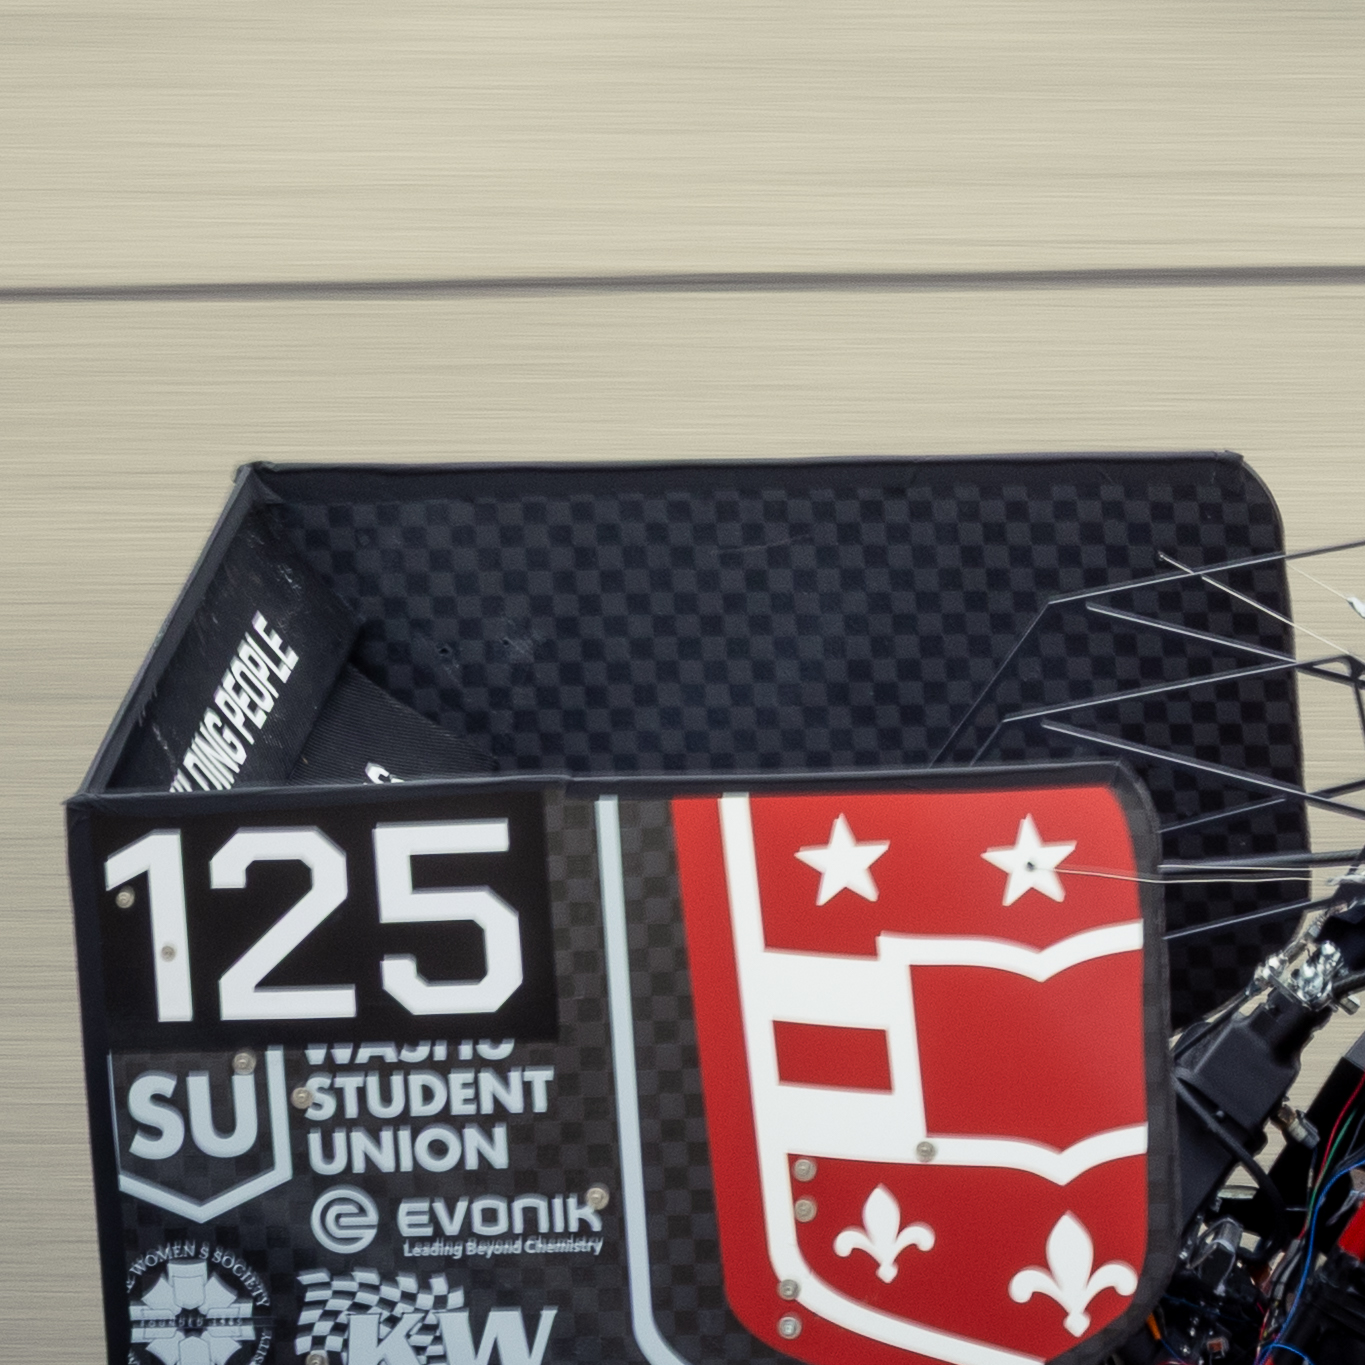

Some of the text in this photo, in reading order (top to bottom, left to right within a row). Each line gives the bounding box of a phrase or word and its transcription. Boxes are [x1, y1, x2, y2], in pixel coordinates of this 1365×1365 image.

[213, 610, 299, 745] PEOPLE
[105, 819, 523, 1022] 125
[128, 1071, 259, 1160] SU
[303, 1066, 556, 1121] STUDENT
[306, 1122, 510, 1175] UNION
[396, 1193, 603, 1237] EVONIK
[211, 1246, 271, 1307] SOCIETY
[403, 1237, 604, 1259] Leading Beyond Chemistry
